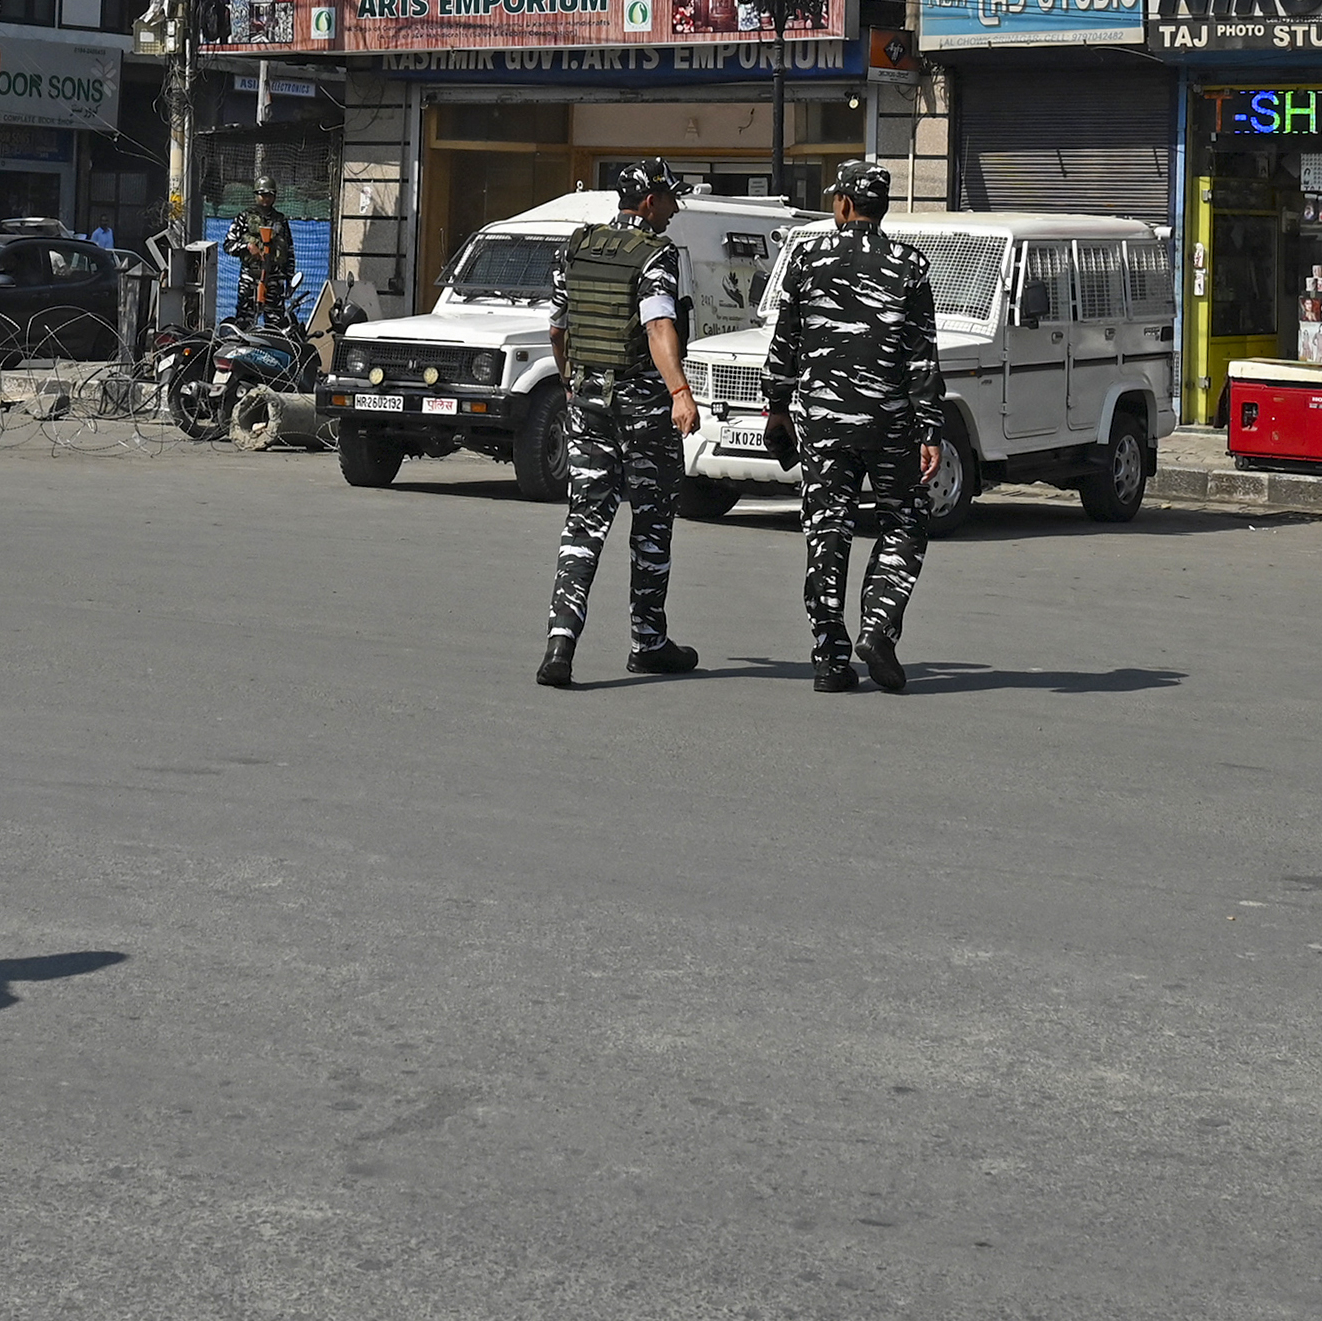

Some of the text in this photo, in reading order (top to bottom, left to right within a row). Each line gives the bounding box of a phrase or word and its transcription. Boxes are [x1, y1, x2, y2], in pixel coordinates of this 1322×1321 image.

[1158, 25, 1209, 48] TAJ
[1217, 24, 1265, 37] PHOTO
[382, 49, 495, 70] KASHMIR
[581, 46, 661, 70] ARTS
[673, 40, 844, 70] EMPORIUM
[48, 75, 104, 103] SONS
[240, 78, 311, 94] ASI ELECTRONICS
[703, 322, 739, 336] Call: 144
[426, 398, 454, 412] पुलिस
[728, 431, 763, 446] JK02B
